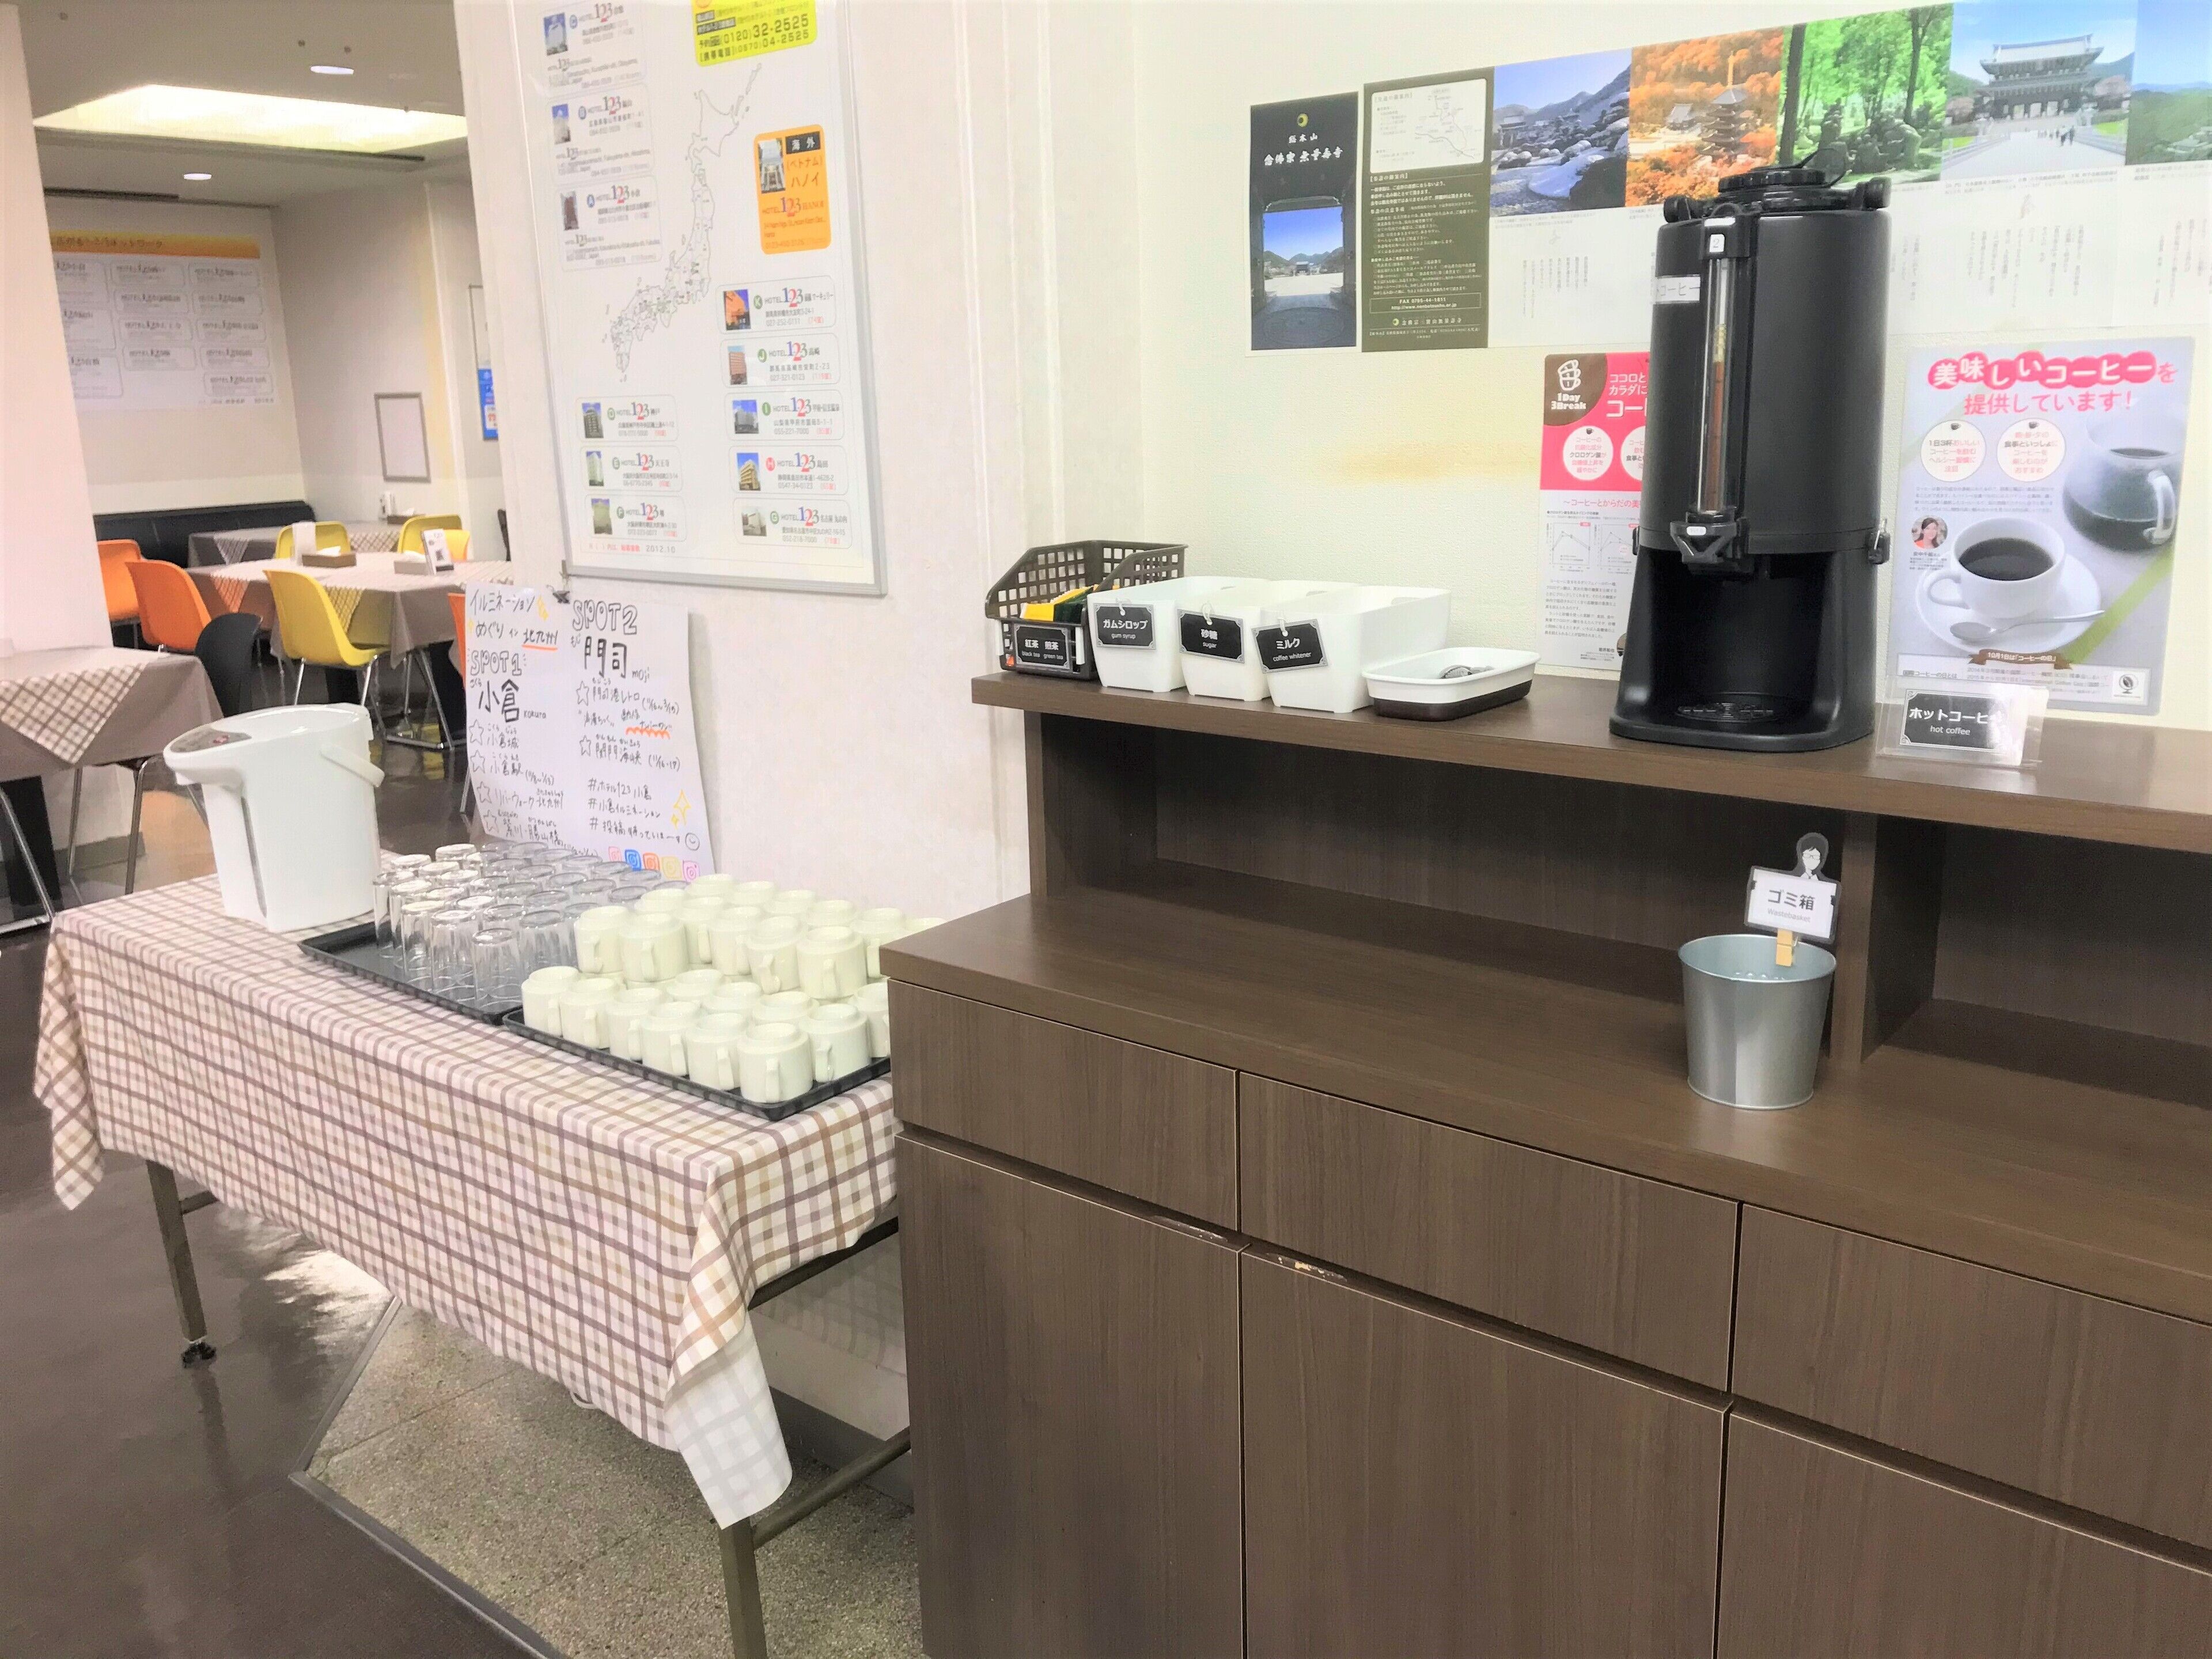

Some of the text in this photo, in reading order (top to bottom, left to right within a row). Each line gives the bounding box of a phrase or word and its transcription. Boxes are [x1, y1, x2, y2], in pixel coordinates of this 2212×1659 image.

[791, 172, 819, 187] ハノイ
[781, 196, 801, 217] 123
[1713, 238, 1719, 248] 2
[782, 287, 804, 308] 123
[787, 341, 808, 361] 123
[1609, 372, 1647, 383] ココロと
[1934, 357, 2179, 387] 美味しいコーヒーを
[1557, 393, 1581, 403] 1Day
[1609, 384, 1647, 396] カラダに
[631, 402, 649, 420] 123
[790, 396, 811, 416] 123
[1551, 400, 1586, 410] 3Break
[1606, 397, 1648, 418] コー
[636, 452, 654, 471] 123
[794, 452, 816, 472] 123
[641, 502, 659, 521] 123
[781, 513, 799, 521] HOTEL
[798, 506, 820, 527] 123
[470, 589, 535, 616] イルミネーション
[1103, 619, 1149, 630] ガムシロップ
[1200, 628, 1218, 640] 砂糖
[1024, 639, 1039, 648] 紅茶
[1276, 638, 1301, 649] ミルク
[584, 636, 627, 679] 門司
[1289, 652, 1312, 660] whitener
[478, 679, 520, 722] 小倉
[1930, 725, 1971, 736] hot coffee
[1767, 889, 1816, 911] ゴミ箱
[1768, 908, 1811, 923] Wastebasket
